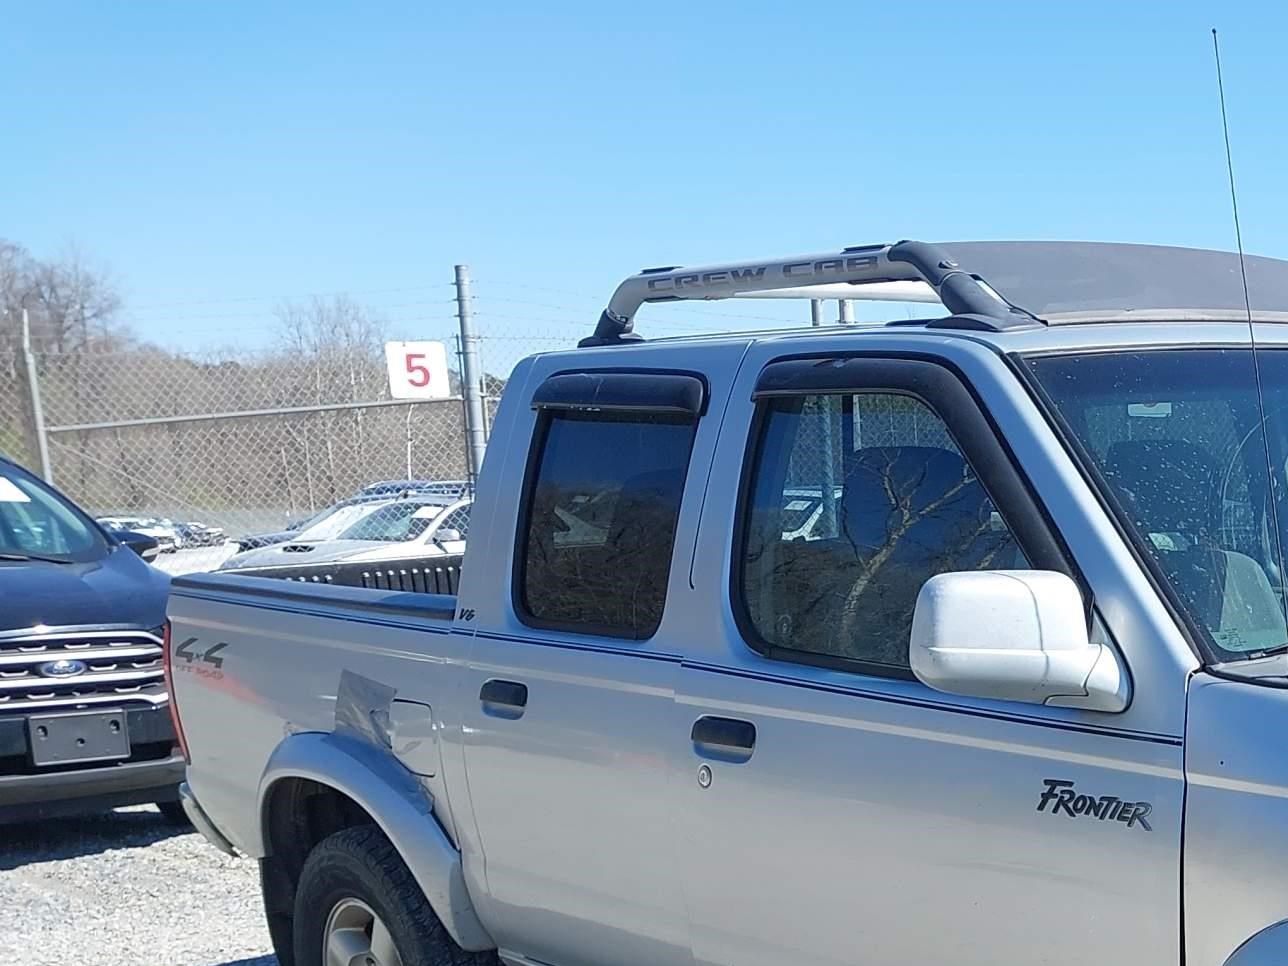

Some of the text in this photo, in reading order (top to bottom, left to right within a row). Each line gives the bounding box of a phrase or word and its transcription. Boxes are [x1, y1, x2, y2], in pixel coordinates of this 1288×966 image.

[648, 255, 878, 292] CREW CAB
[406, 353, 430, 387] 5
[459, 608, 476, 622] V6
